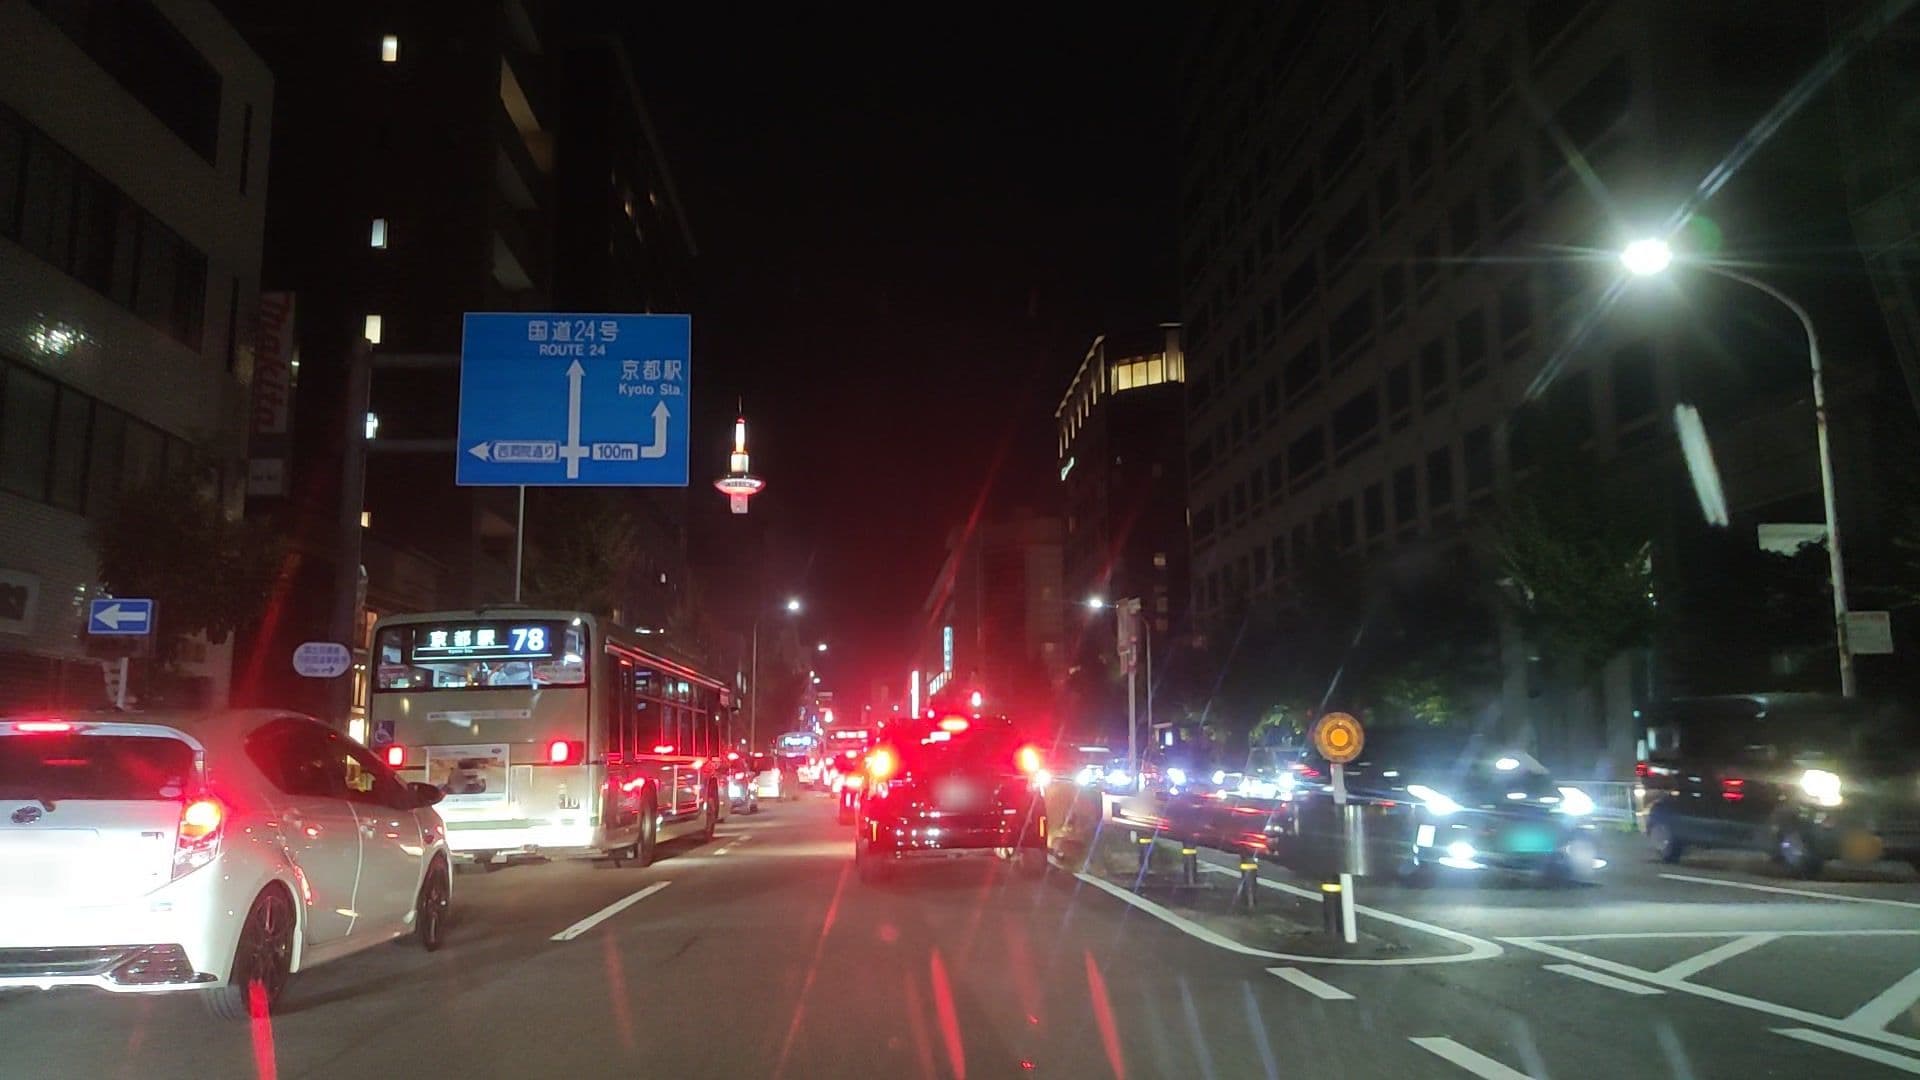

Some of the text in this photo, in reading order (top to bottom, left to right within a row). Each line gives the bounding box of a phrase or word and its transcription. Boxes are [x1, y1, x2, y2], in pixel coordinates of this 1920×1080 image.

[528, 319, 619, 342] 国道24号
[539, 344, 606, 356] ROUTE 24
[620, 359, 682, 381] 京都駅
[619, 383, 654, 397] Kyoto
[598, 445, 633, 459] 100m
[511, 627, 545, 652] 78
